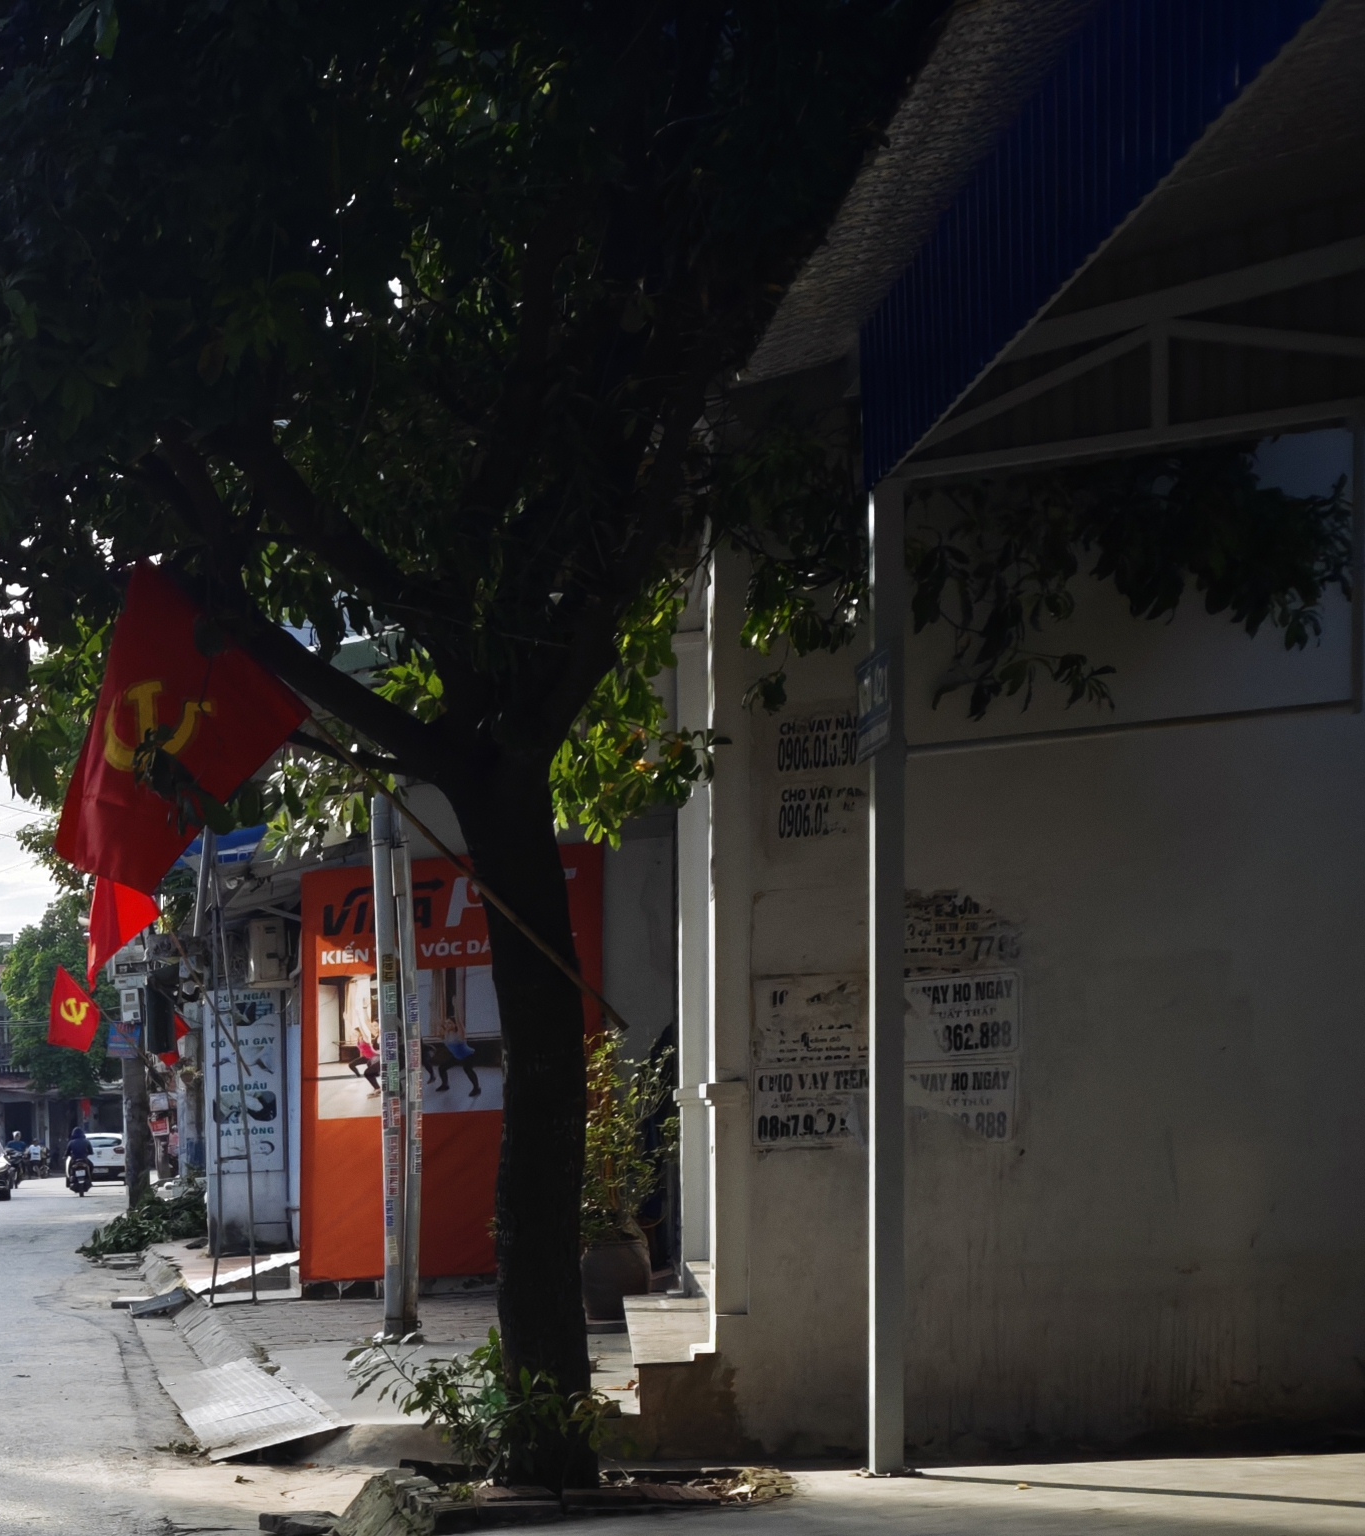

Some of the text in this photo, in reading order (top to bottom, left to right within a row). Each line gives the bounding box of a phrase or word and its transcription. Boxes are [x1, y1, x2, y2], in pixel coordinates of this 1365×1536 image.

[809, 718, 832, 733] VAY
[781, 788, 806, 803] CHO
[322, 940, 369, 966] KIẾN
[420, 937, 462, 958] VÓC
[797, 1071, 829, 1091] VAY
[950, 1072, 969, 1095] HỌ
